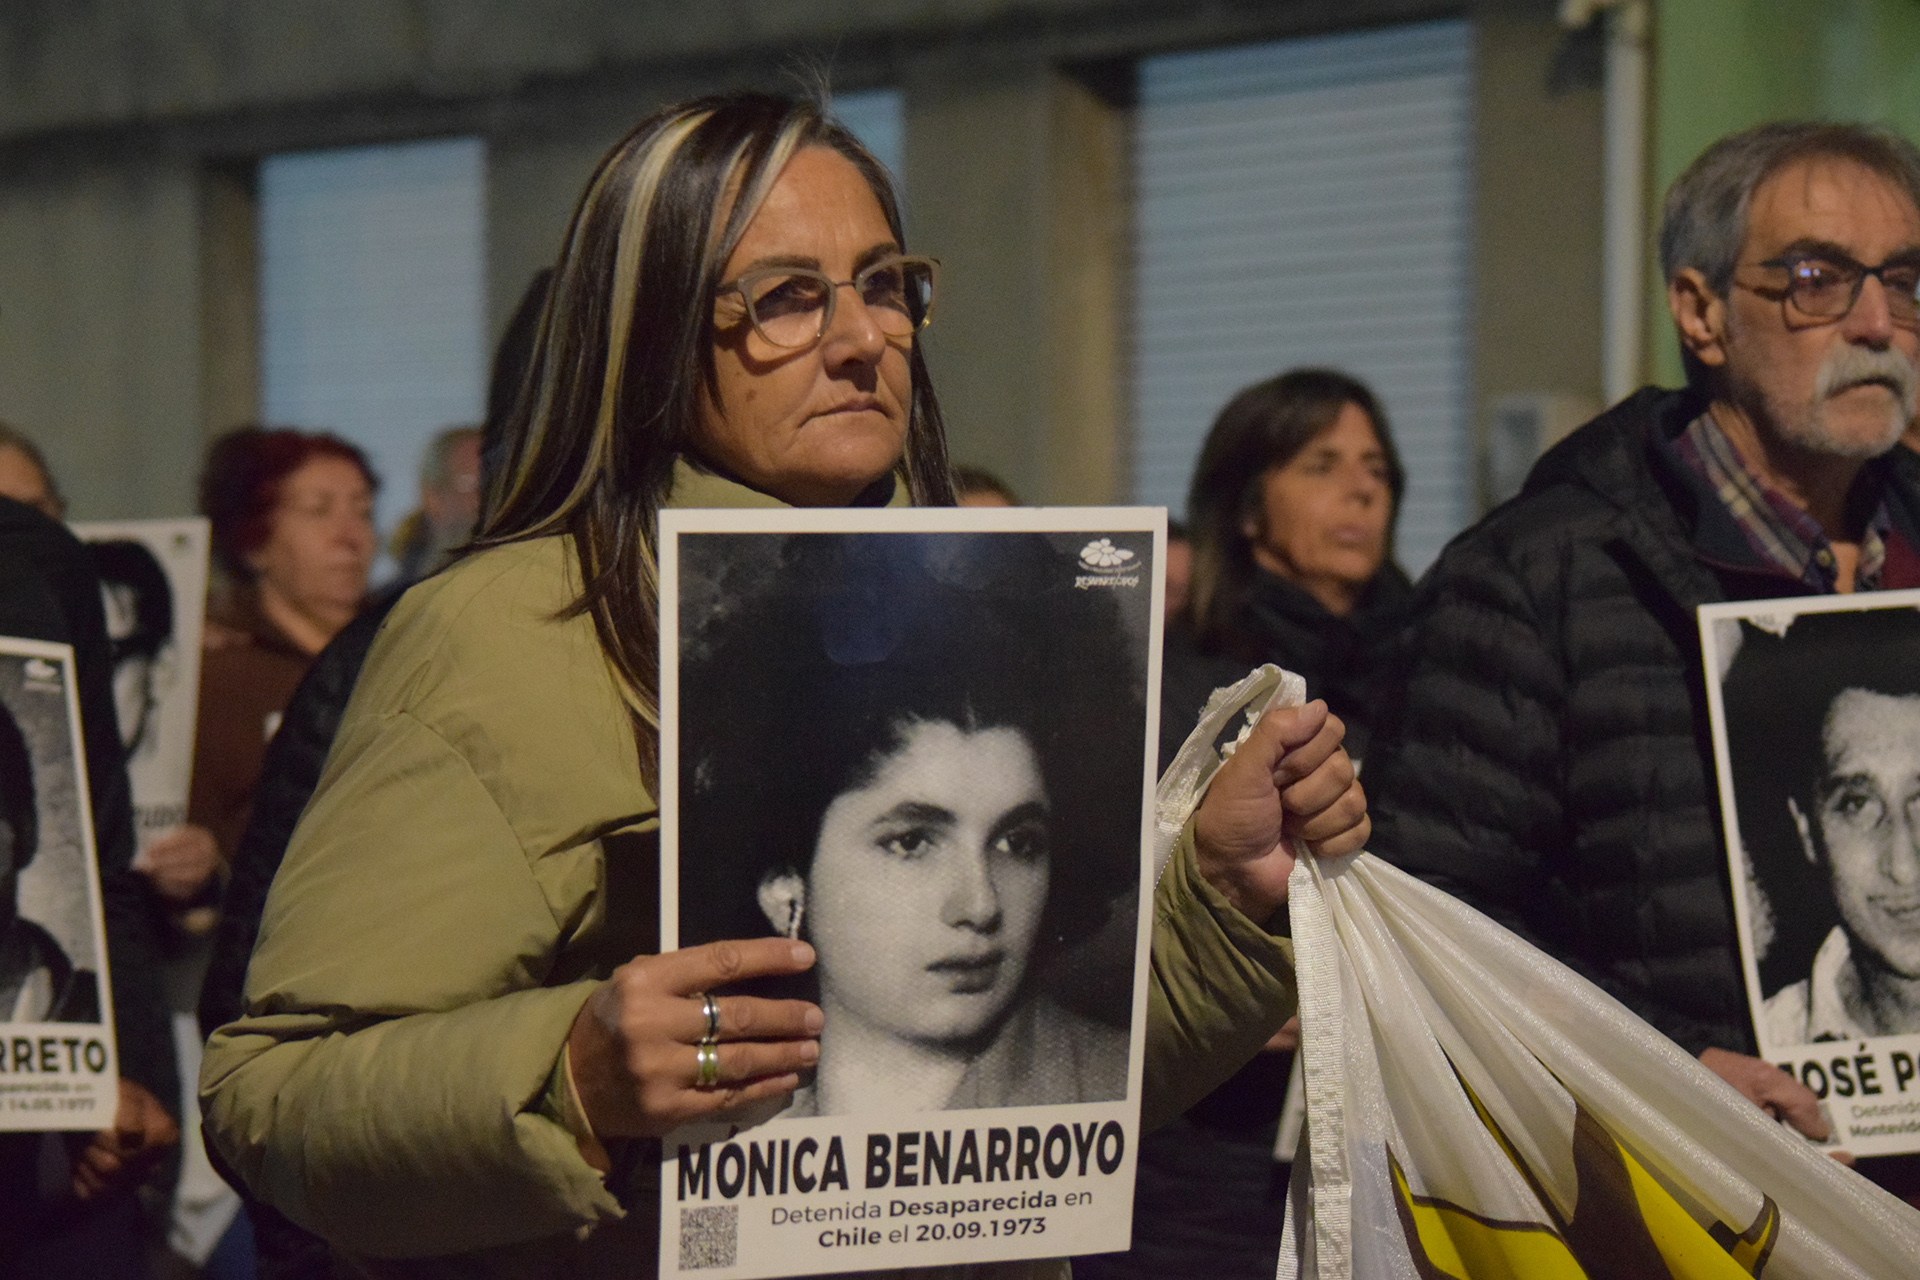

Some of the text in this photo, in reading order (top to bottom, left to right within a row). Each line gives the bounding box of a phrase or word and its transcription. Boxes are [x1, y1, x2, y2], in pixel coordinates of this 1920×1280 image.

[0, 1036, 107, 1074] RETO
[1890, 1050, 1920, 1092] P
[677, 1120, 1125, 1201] MÓNICA BENARROYO
[772, 1191, 1092, 1225] Detenida Desaparecida en
[818, 1217, 1046, 1248] Chile el 20.09.1973
